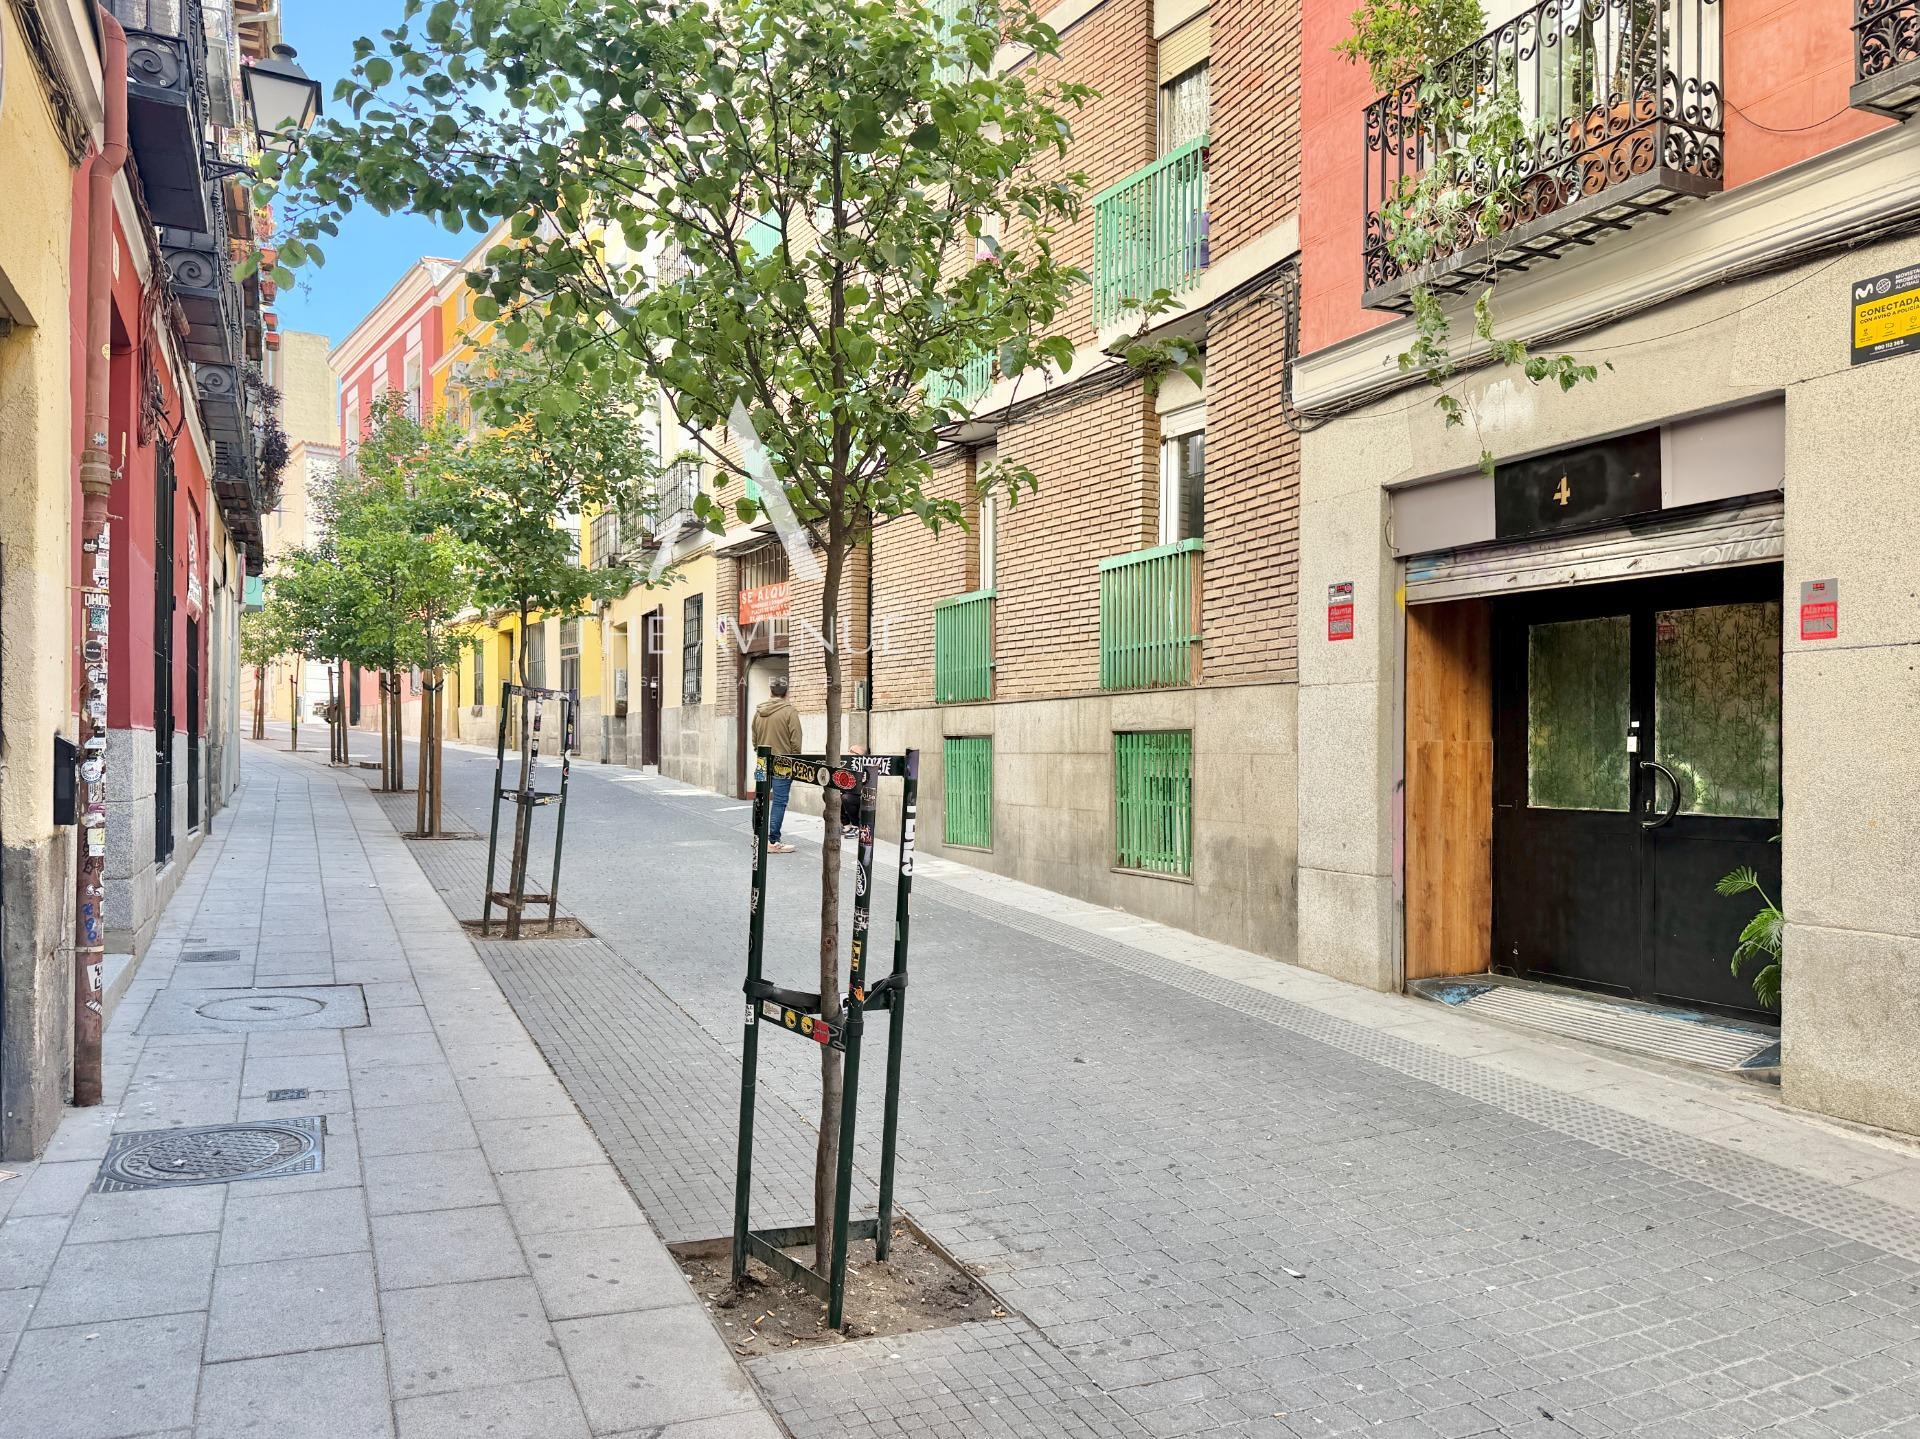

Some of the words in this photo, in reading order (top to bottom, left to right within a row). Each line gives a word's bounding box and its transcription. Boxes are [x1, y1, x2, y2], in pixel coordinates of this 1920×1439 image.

[1860, 296, 1920, 318] CONECTADA
[1860, 317, 1873, 325] CON
[1873, 312, 1891, 321] AVISO
[1553, 476, 1570, 505] 4
[741, 592, 753, 605] SE
